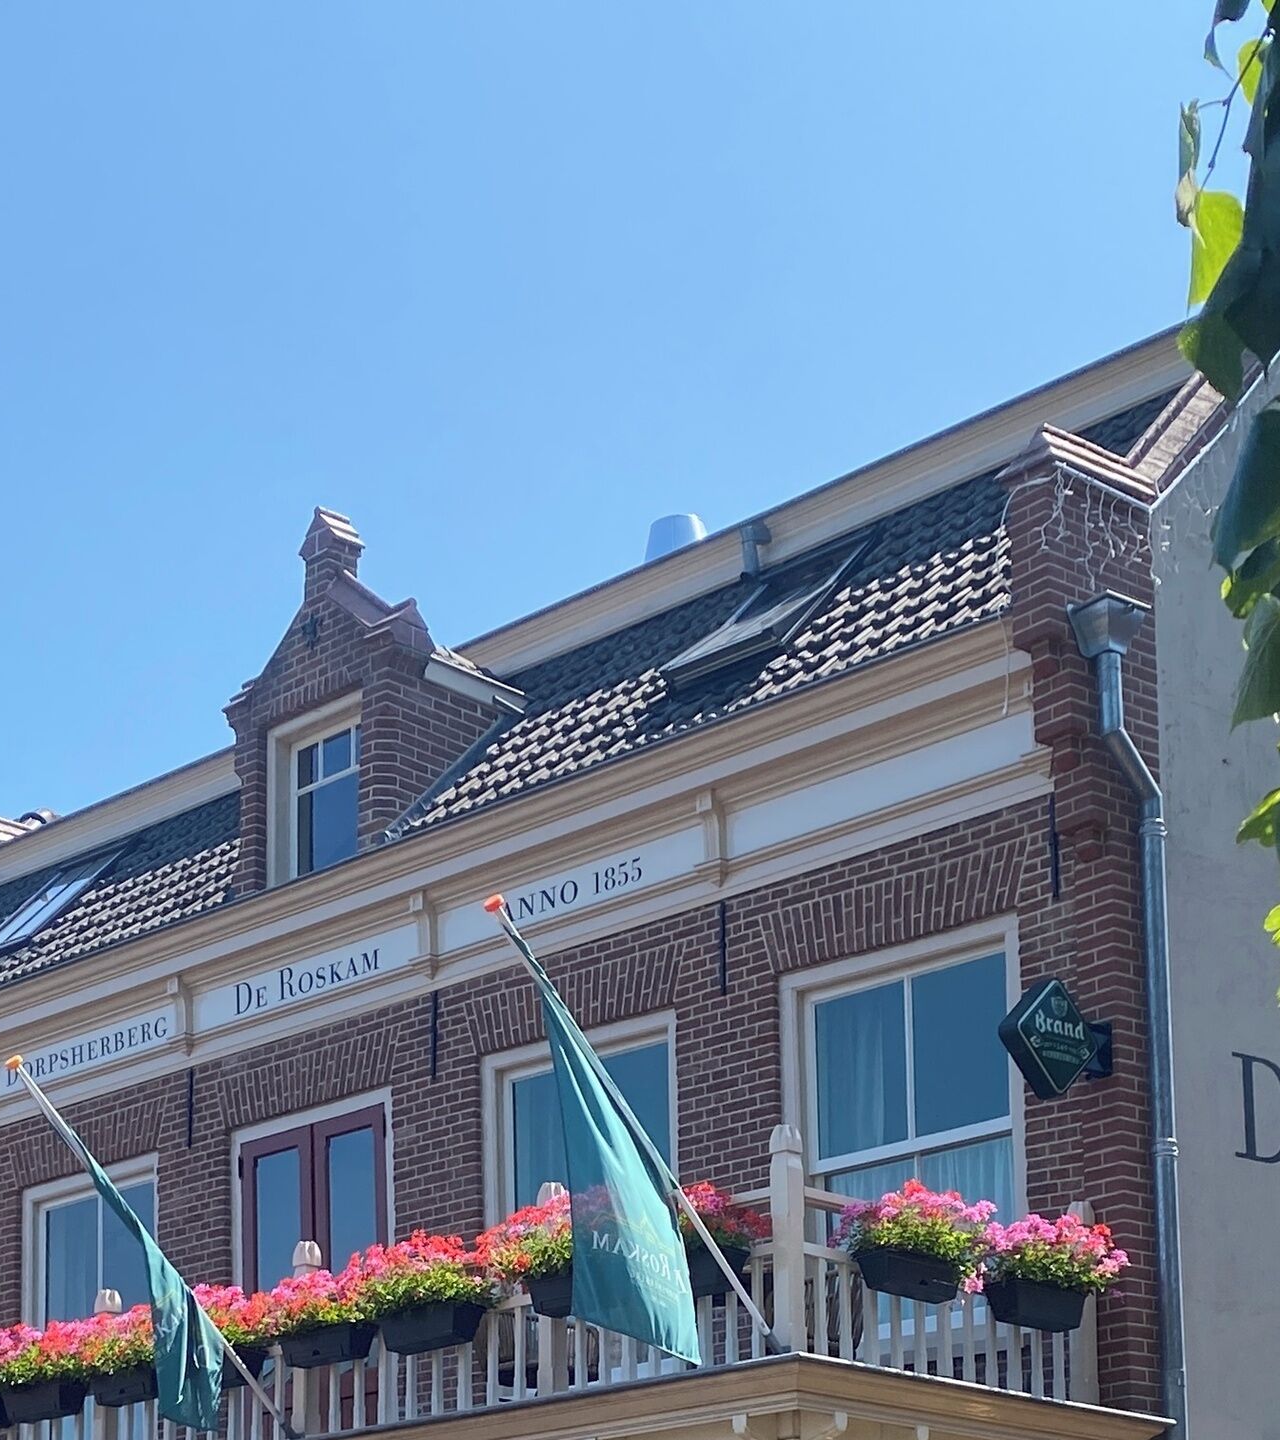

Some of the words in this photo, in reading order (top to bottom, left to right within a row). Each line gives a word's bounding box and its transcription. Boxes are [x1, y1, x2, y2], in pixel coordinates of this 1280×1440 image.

[592, 855, 643, 895] 1855
[1035, 1009, 1085, 1041] Brand
[4, 1015, 169, 1088] DORPSHERBERG
